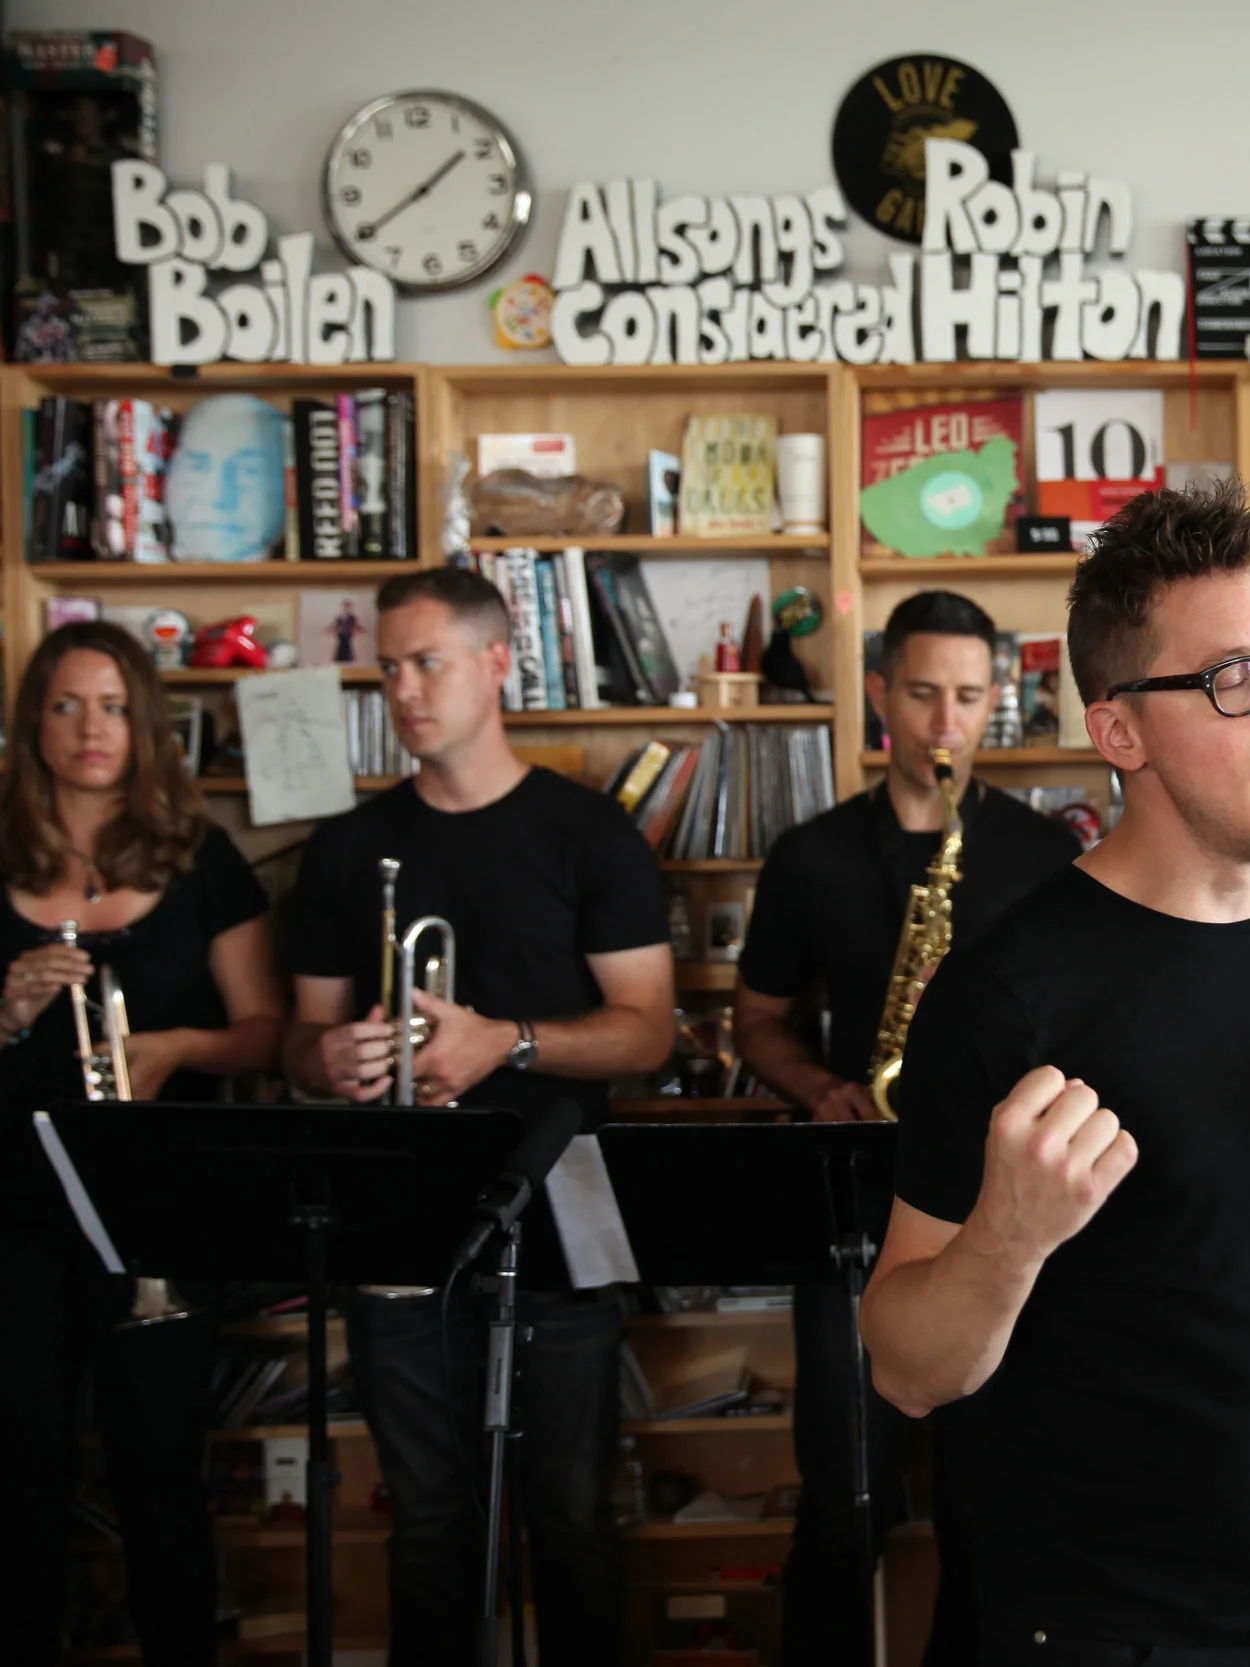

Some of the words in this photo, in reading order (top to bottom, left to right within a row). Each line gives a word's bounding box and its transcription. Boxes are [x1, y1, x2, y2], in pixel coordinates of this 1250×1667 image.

[872, 60, 966, 111] LOVE
[111, 158, 268, 272] Bob
[922, 137, 1133, 256] Robin
[148, 232, 396, 365] Boilen
[550, 251, 916, 365] Considered
[922, 251, 1184, 362] Hilton
[1046, 418, 1147, 481] 10
